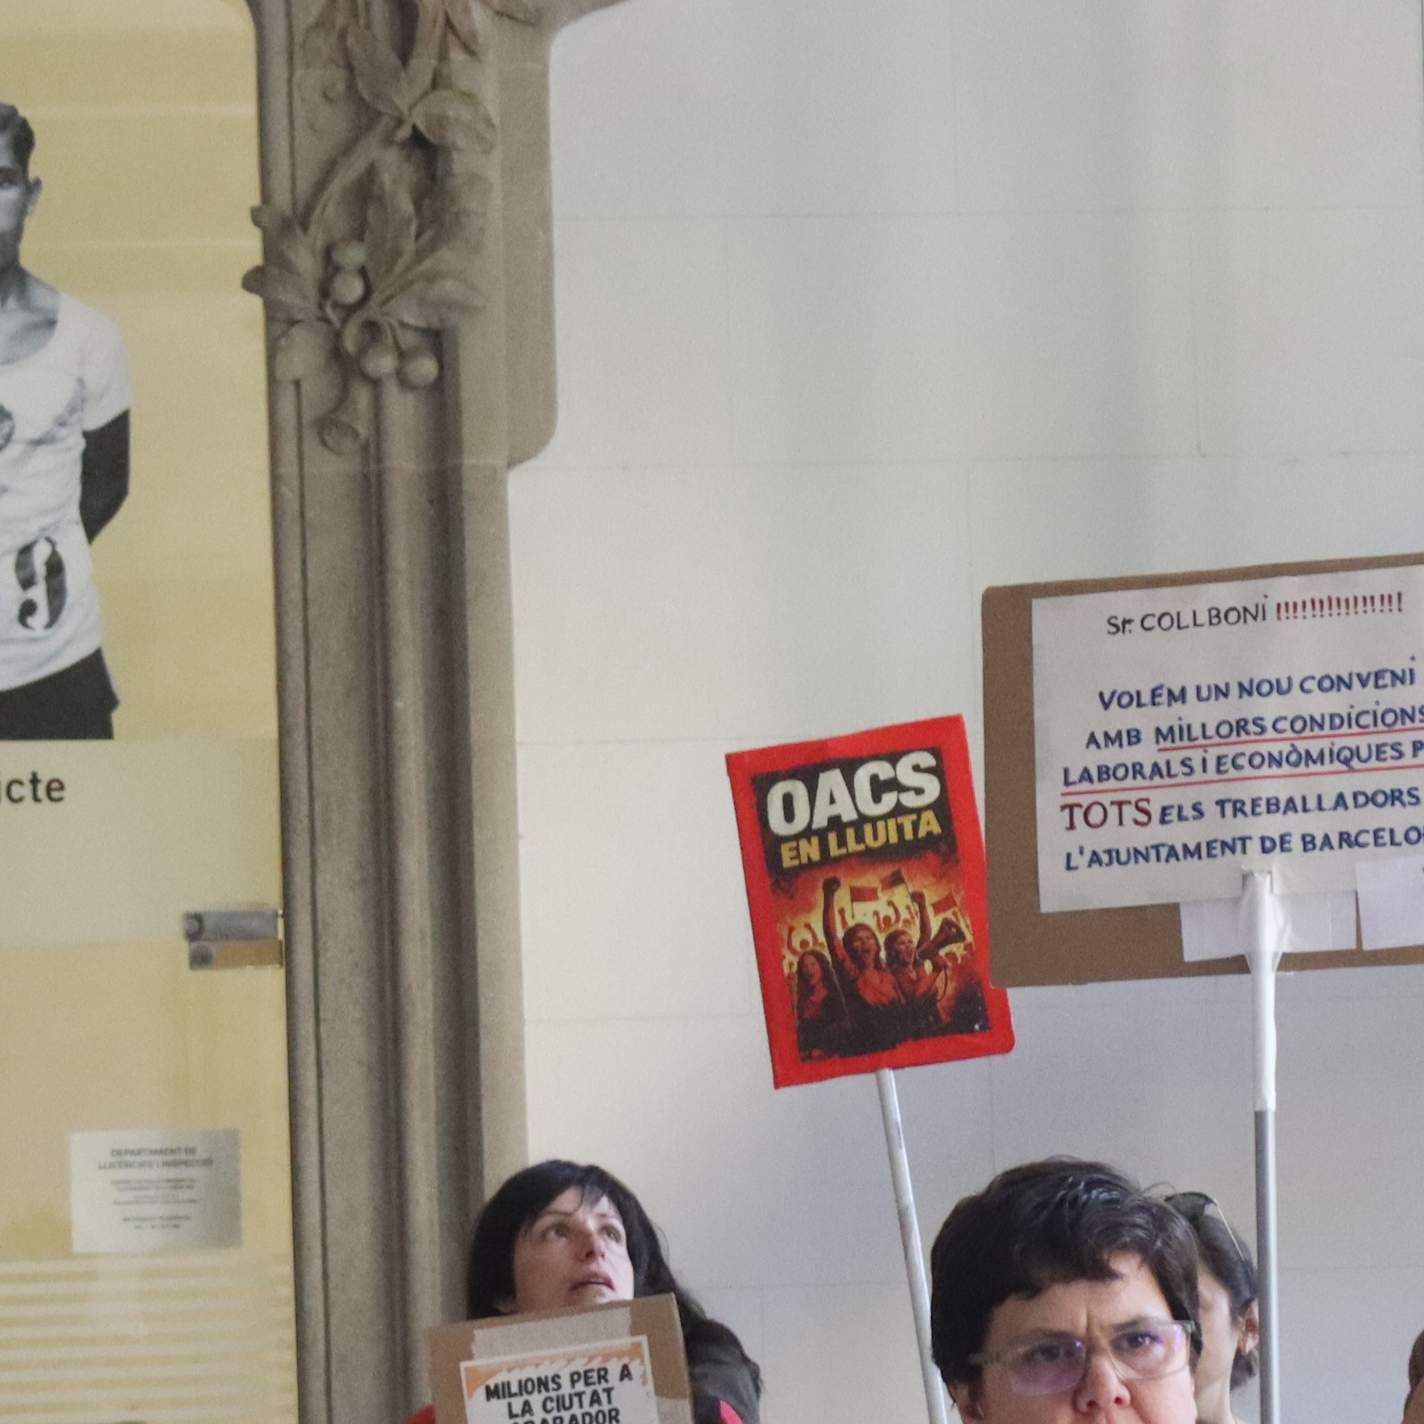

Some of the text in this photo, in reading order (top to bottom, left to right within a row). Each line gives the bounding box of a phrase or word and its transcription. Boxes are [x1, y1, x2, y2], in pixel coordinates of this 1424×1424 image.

[1196, 682, 1230, 702] UN
[1238, 676, 1292, 700] NOU
[1086, 728, 1142, 750] AMB
[1063, 756, 1194, 787] LABORALS
[767, 750, 941, 837] OACS
[1060, 799, 1152, 831] TOTS
[1158, 801, 1205, 825] ELS
[1216, 787, 1420, 820] TREBALLADORS
[781, 810, 942, 868] EN LLUITA
[1065, 836, 1252, 871] L'AJUNTAMENT
[1260, 832, 1292, 855] DE
[485, 1363, 633, 1402] MILIONS PER A
[507, 1386, 615, 1420] LA CIUTAT
